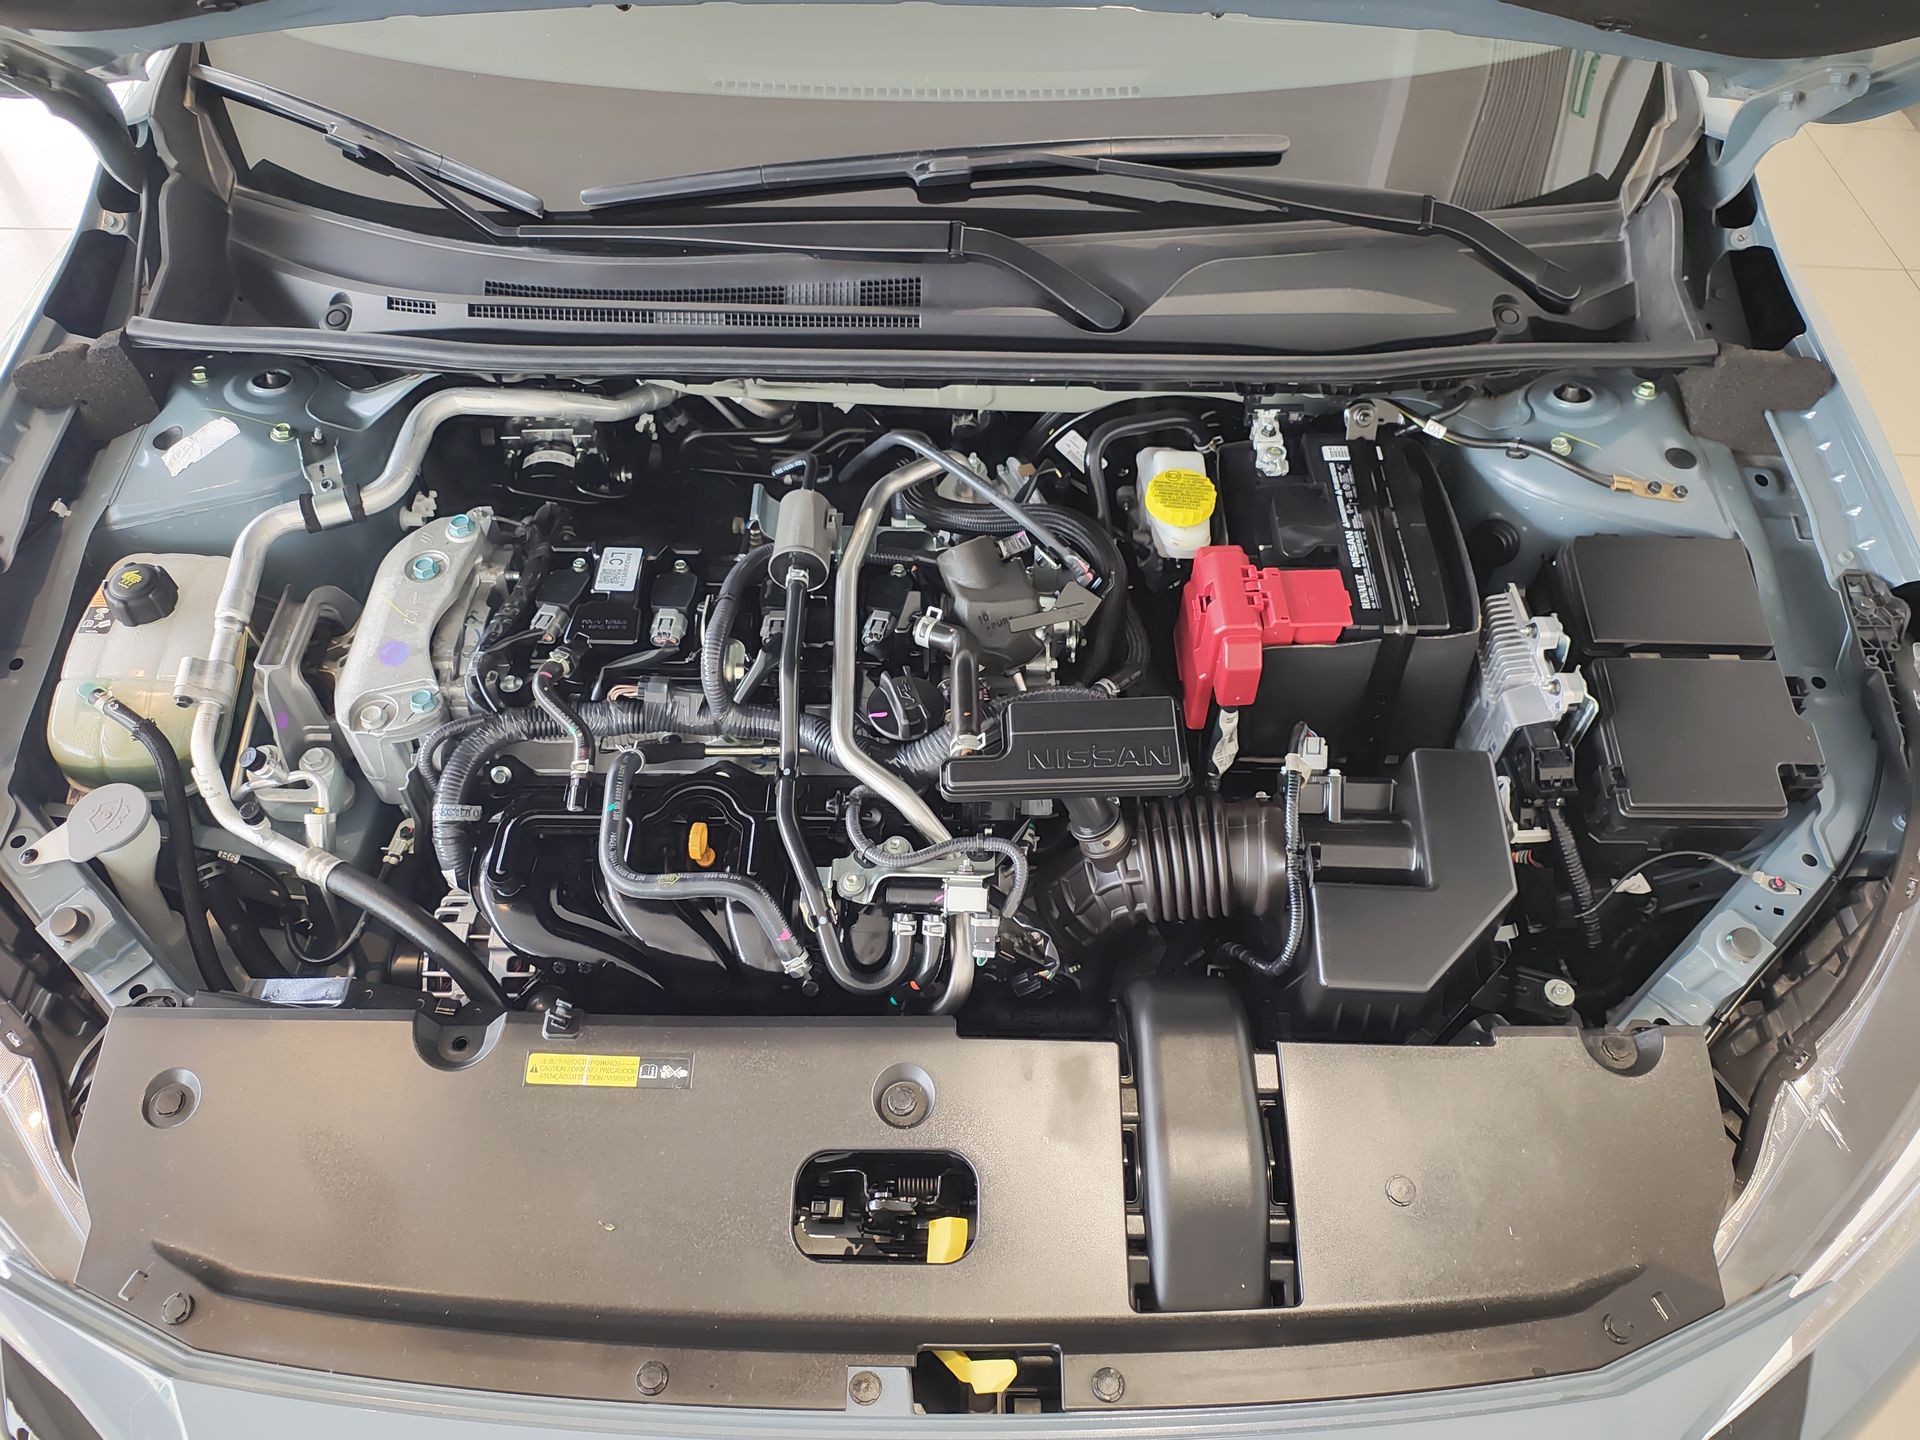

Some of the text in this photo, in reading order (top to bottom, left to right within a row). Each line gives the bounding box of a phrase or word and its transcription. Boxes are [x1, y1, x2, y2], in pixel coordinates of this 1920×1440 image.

[609, 552, 626, 566] LC
[1344, 530, 1361, 568] NISSAN
[1354, 574, 1371, 609] RENAULT
[1027, 744, 1172, 770] NISSAN
[540, 1065, 566, 1073] CAUTION
